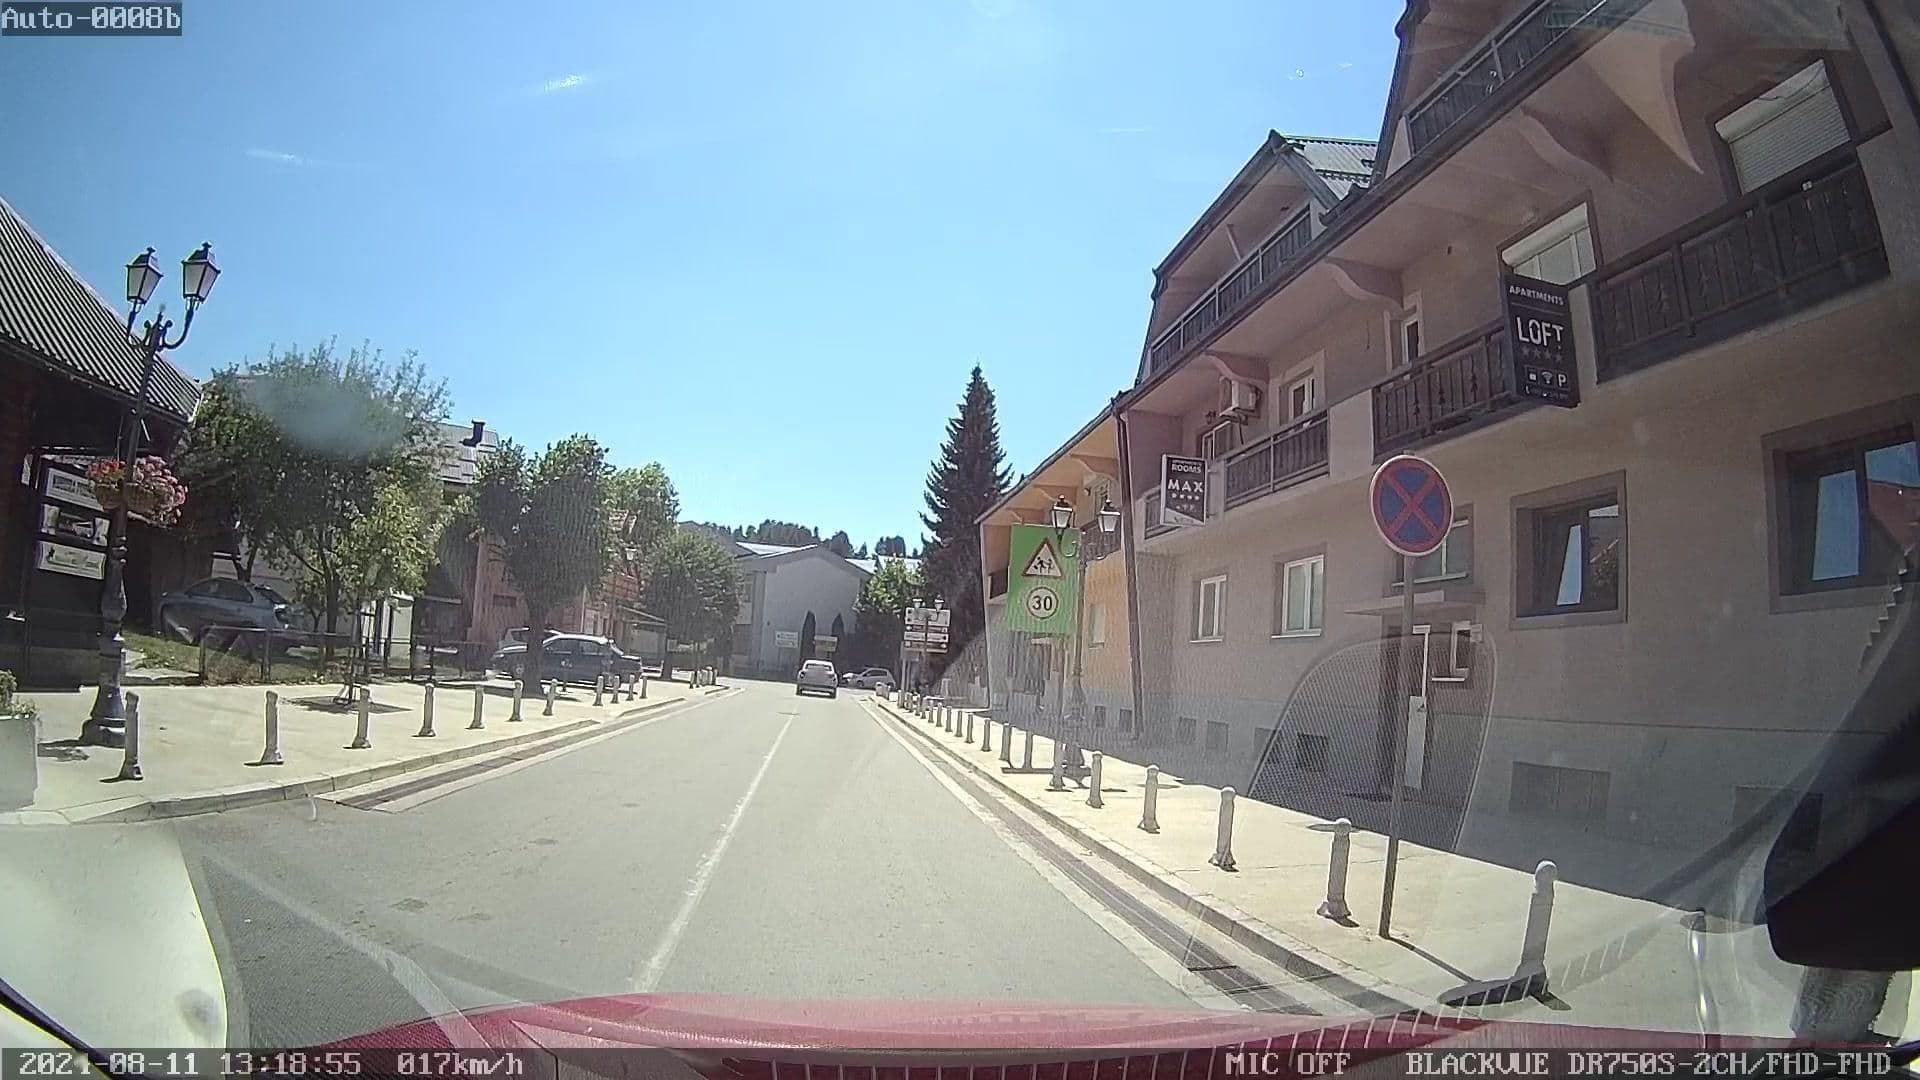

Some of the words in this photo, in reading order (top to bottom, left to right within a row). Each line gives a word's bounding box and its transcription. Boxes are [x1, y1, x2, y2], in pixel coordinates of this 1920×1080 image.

[1509, 285, 1564, 306] APARTMENTS
[1516, 317, 1564, 347] LOFT
[1557, 373, 1567, 387] P
[1171, 463, 1202, 474] ROOMS
[1167, 478, 1204, 493] MAX
[1031, 595, 1054, 612] 30
